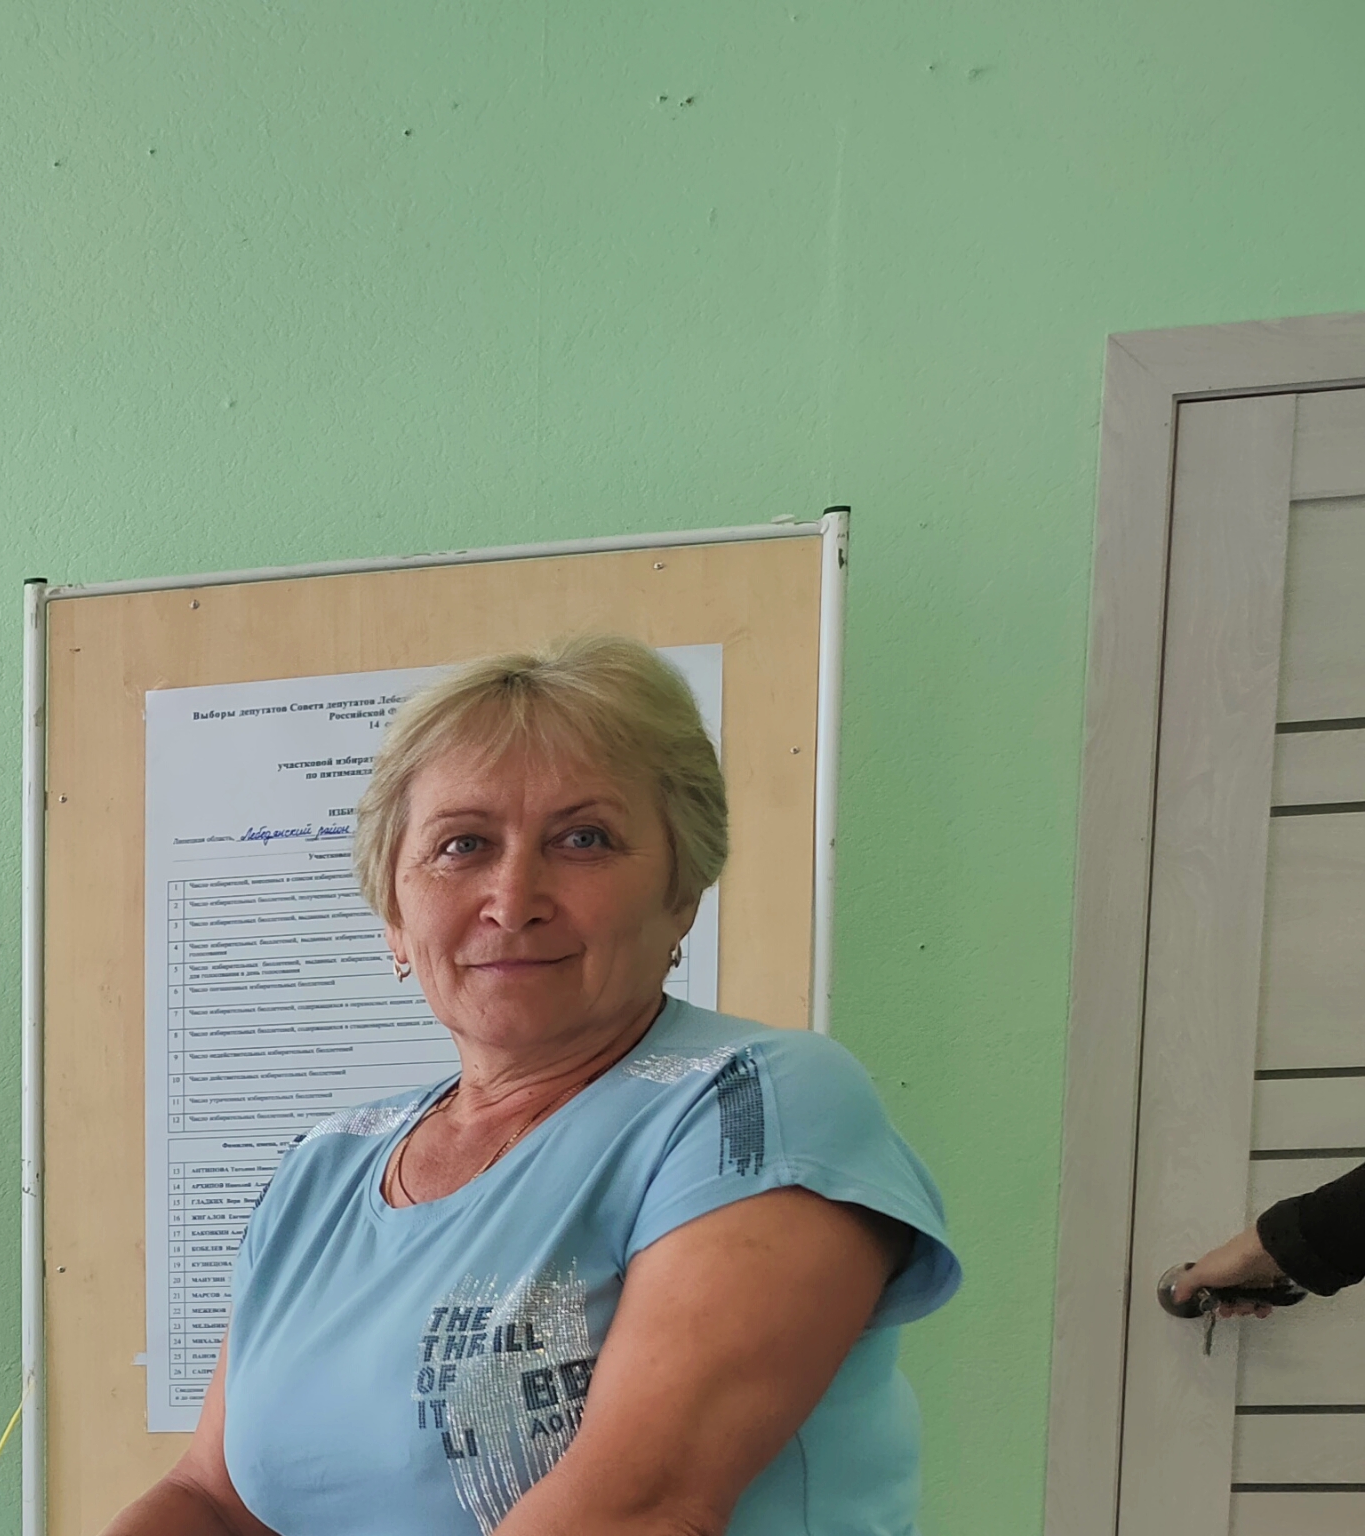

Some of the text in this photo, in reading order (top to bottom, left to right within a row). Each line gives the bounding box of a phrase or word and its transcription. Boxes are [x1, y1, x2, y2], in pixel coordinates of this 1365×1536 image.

[193, 710, 235, 720] Выборы
[239, 706, 287, 717] депутатов
[290, 702, 323, 712] Совета
[326, 698, 375, 709] депутатов
[329, 707, 385, 720] Российской
[369, 721, 379, 729] 14
[278, 756, 375, 772] участковой избират
[306, 768, 373, 779] по пятиманда
[430, 1307, 494, 1332] THE
[422, 1322, 544, 1363] THRILL
[417, 1364, 457, 1395] OF
[417, 1399, 446, 1429] IT
